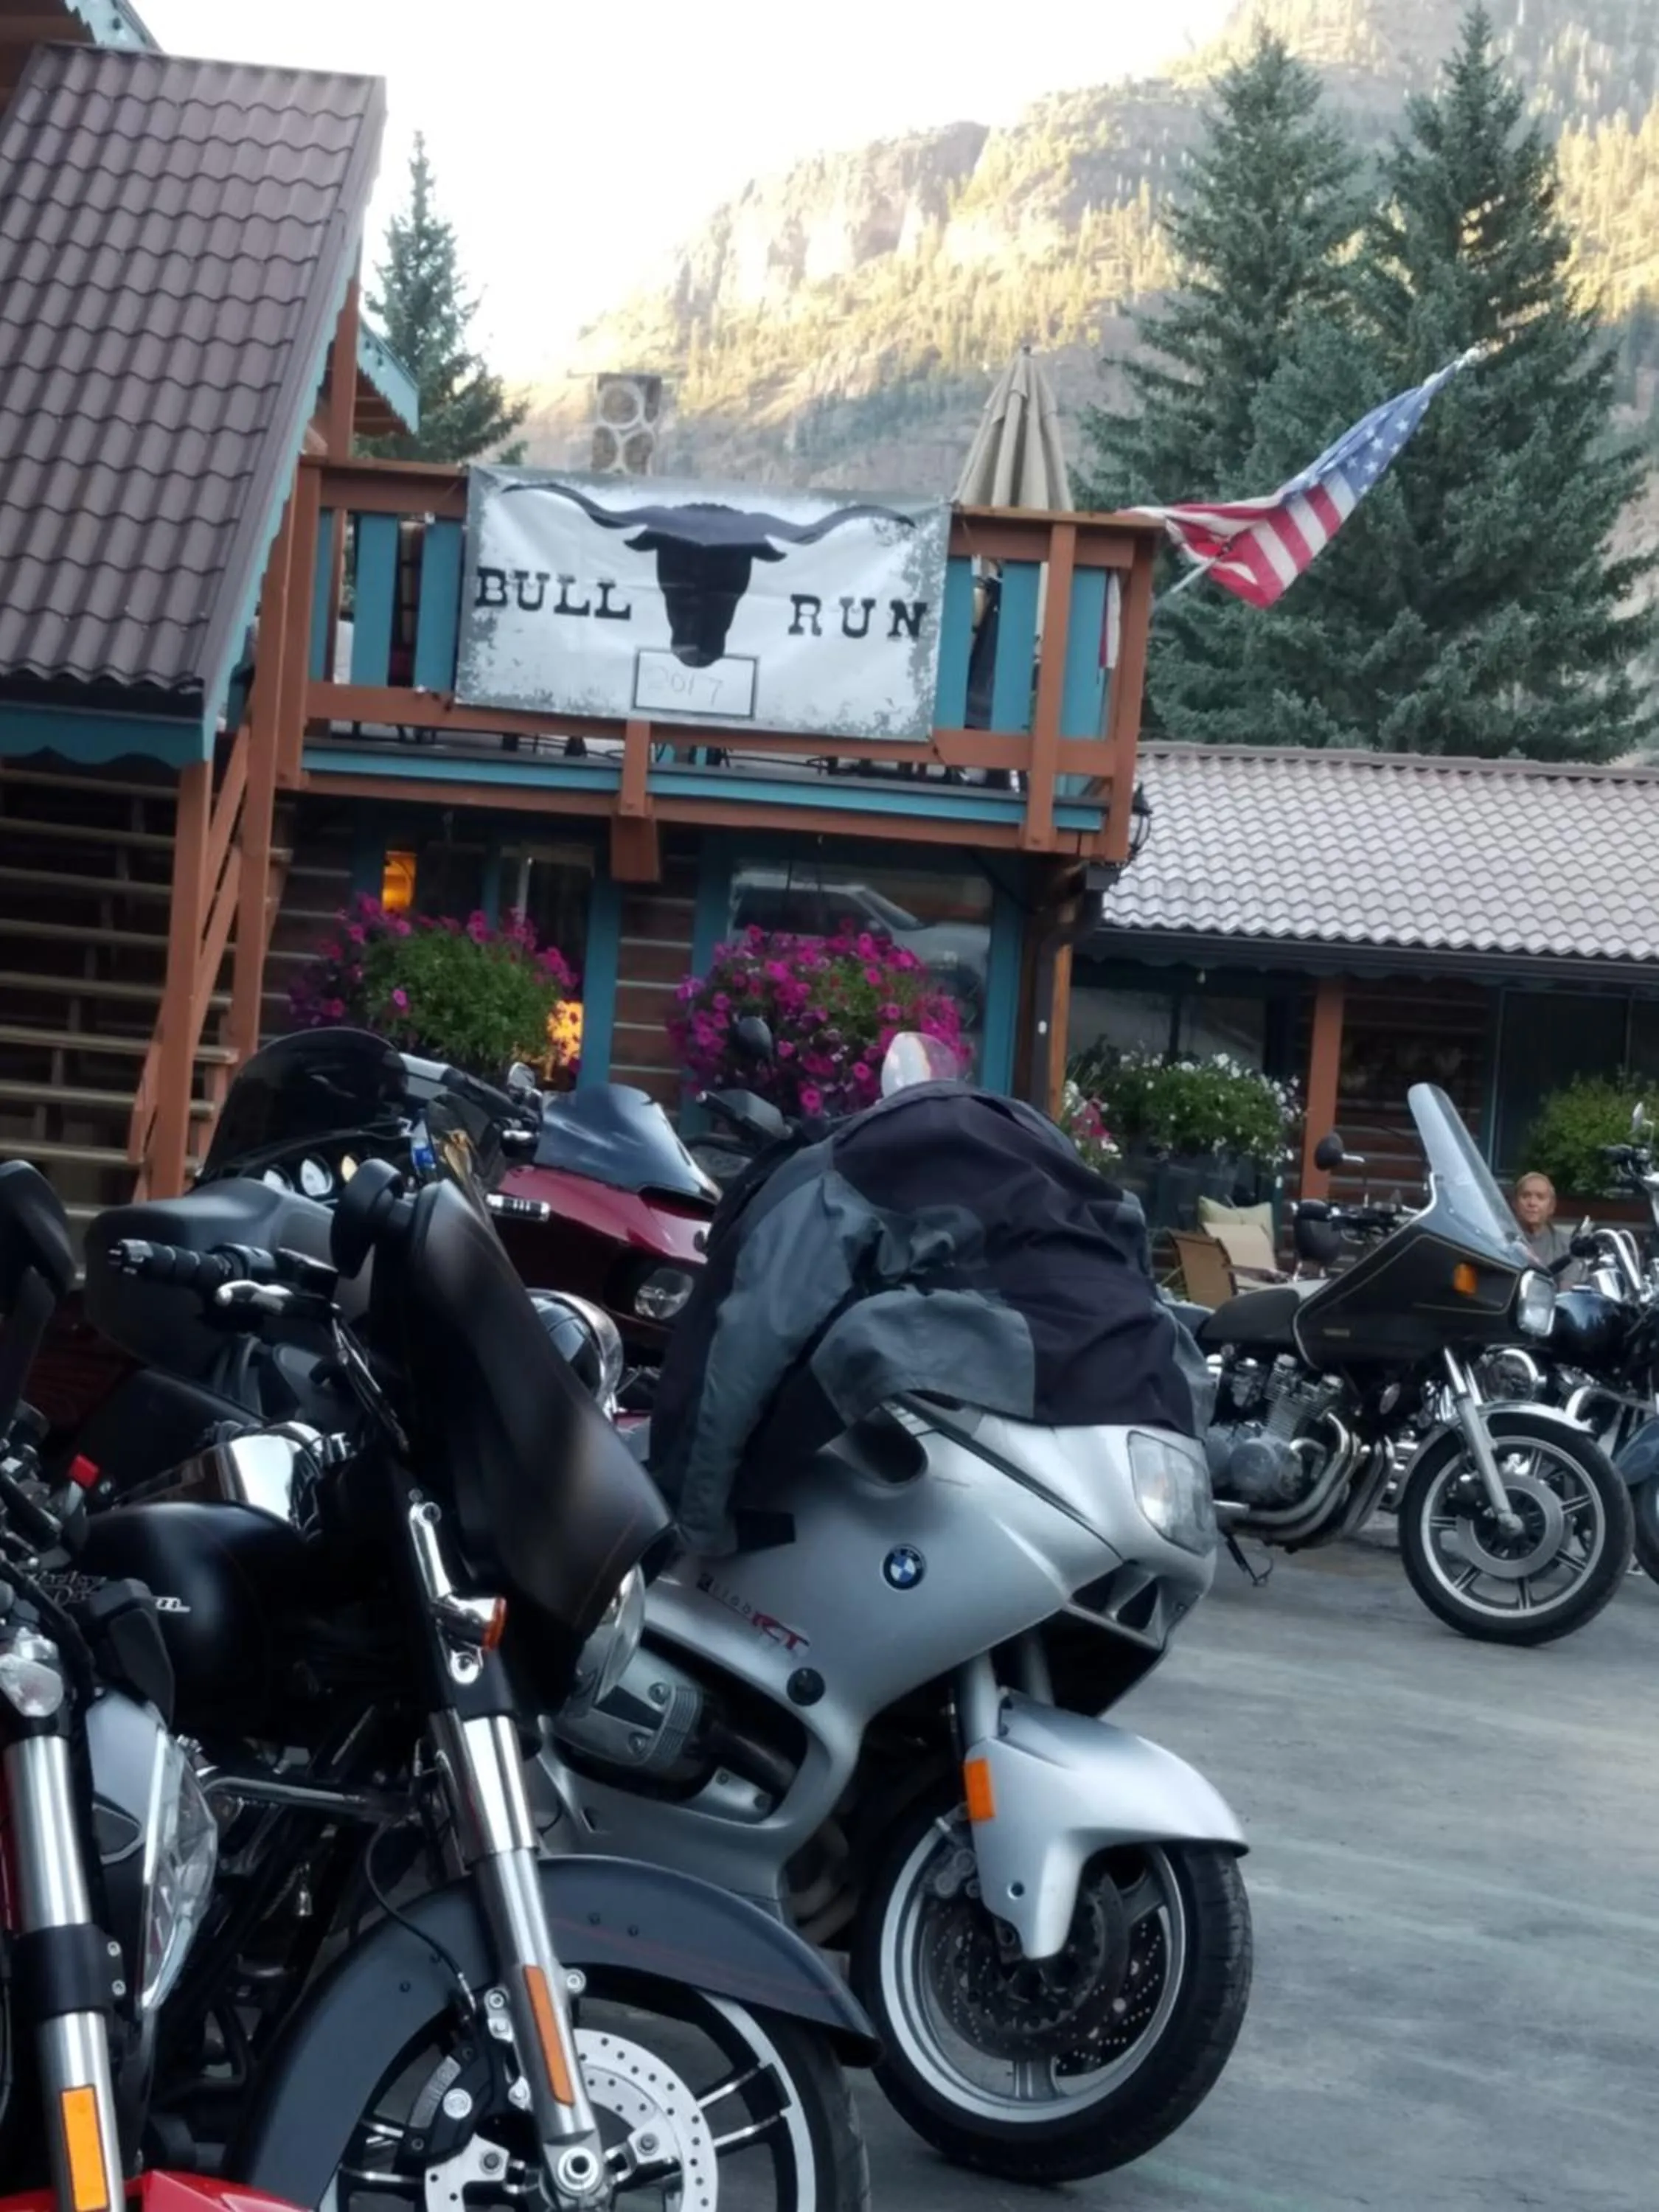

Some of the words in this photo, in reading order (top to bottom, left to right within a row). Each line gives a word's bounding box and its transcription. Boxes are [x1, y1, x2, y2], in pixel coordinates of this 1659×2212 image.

[474, 566, 631, 621] BULL
[787, 594, 928, 639] RUN
[643, 665, 724, 707] 2017
